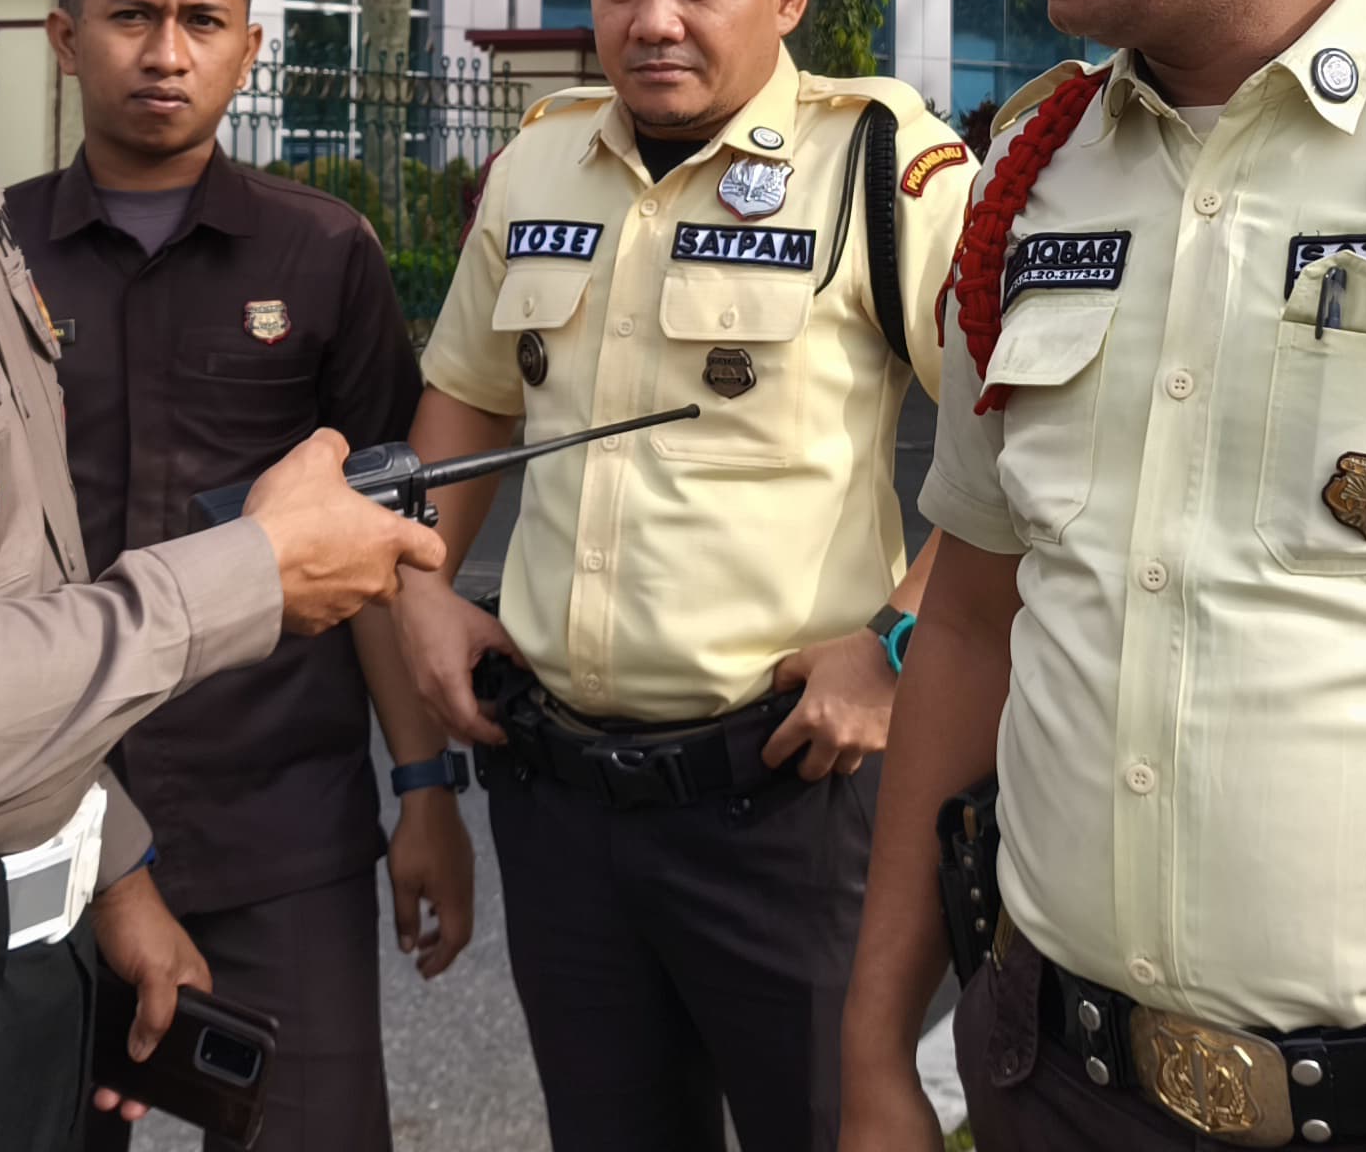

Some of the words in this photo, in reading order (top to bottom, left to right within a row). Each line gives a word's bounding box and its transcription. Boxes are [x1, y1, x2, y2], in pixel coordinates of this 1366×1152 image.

[906, 146, 963, 190] PEKANBARU
[513, 224, 589, 253] YOSE
[680, 227, 807, 263] SATPAM
